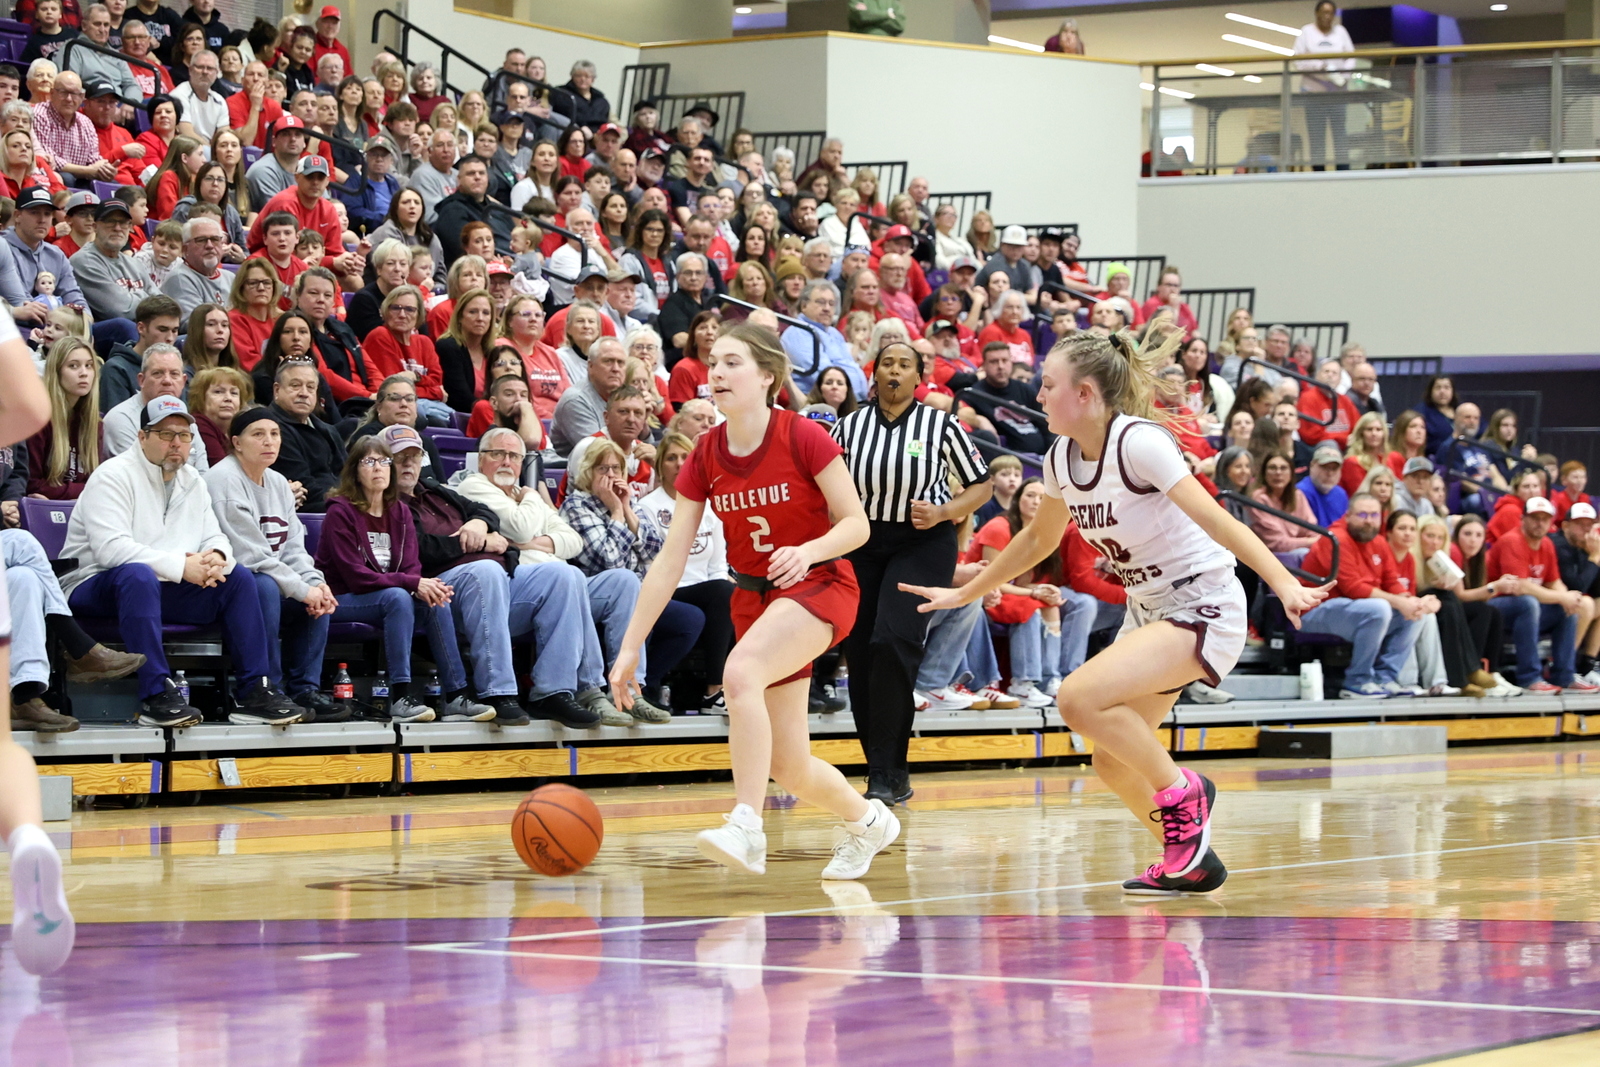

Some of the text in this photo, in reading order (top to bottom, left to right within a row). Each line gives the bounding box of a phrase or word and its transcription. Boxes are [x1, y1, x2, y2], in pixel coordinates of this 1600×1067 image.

[311, 156, 321, 166] B
[713, 482, 792, 513] BELLEVUE
[53, 512, 64, 523] 18
[1069, 501, 1119, 530] GENOA
[746, 515, 775, 552] 2
[1195, 605, 1222, 619] G
